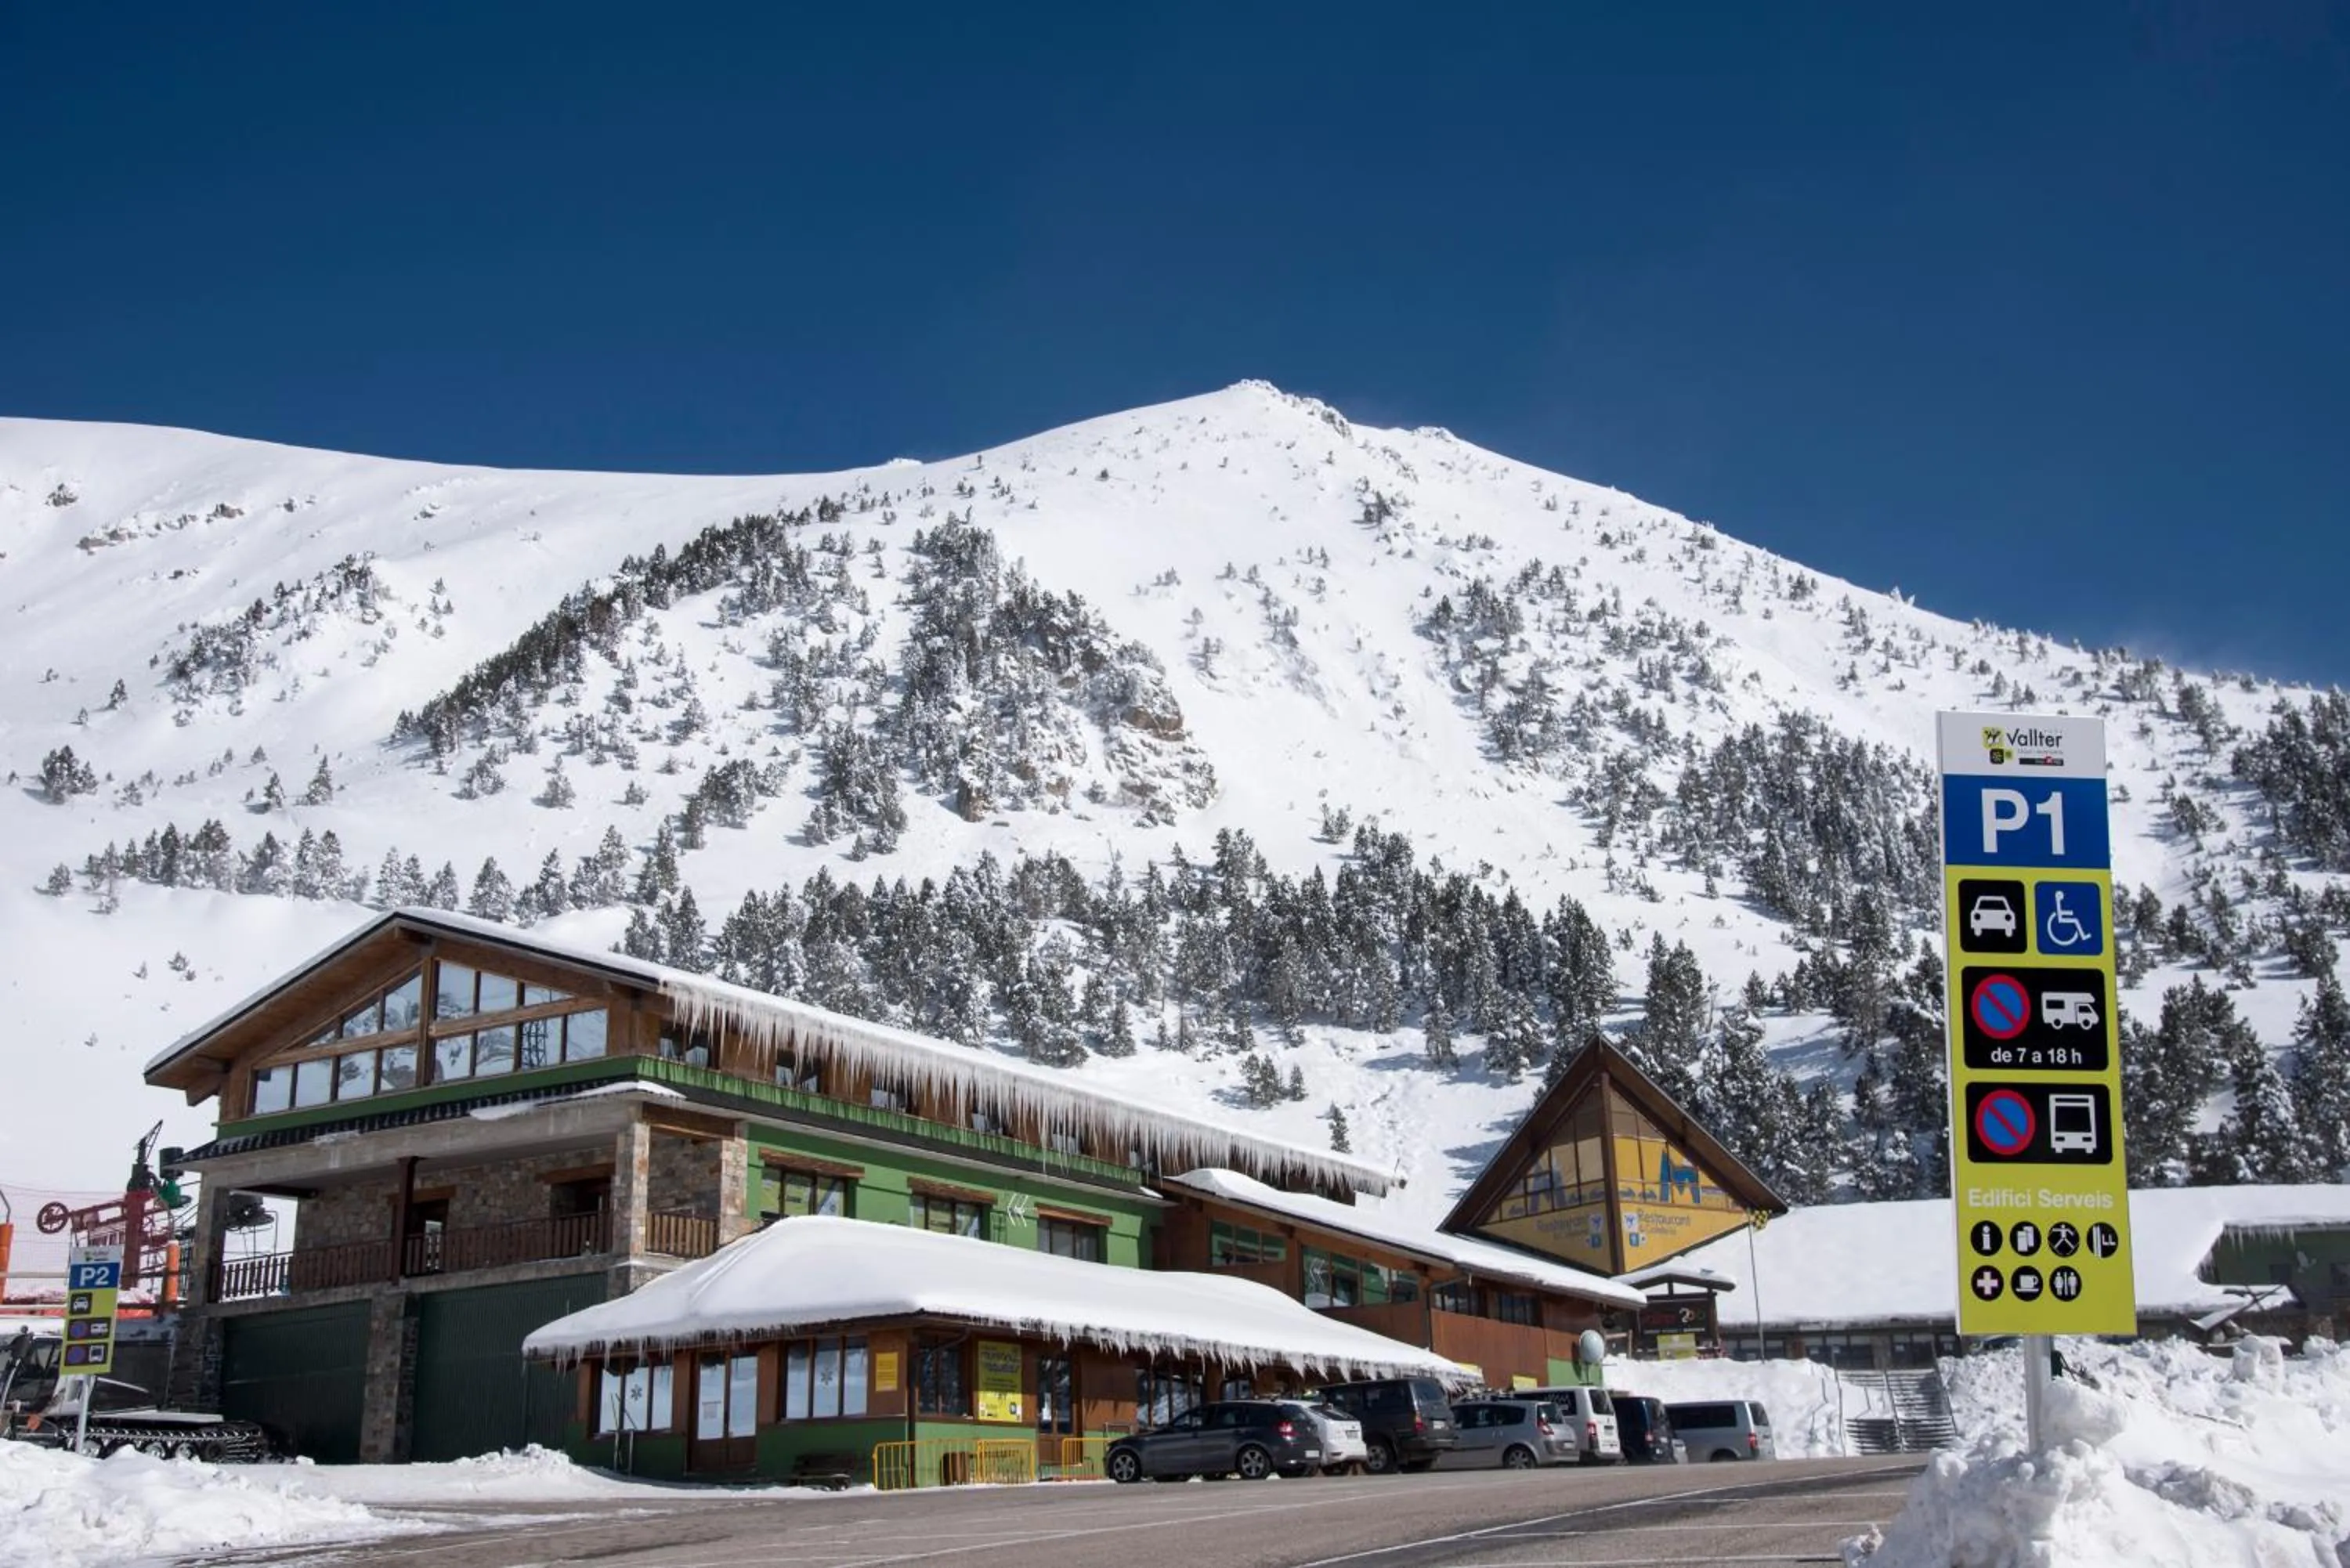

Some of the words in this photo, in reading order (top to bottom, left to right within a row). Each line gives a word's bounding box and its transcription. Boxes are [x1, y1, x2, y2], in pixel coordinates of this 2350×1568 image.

[2007, 728, 2063, 748] Vallter
[1981, 789, 2065, 855] P1
[1990, 1046, 2012, 1063] de
[2016, 1047, 2027, 1063] 7
[2031, 1050, 2042, 1064] a
[2047, 1047, 2068, 1064] 18
[2070, 1047, 2082, 1064] h
[1968, 1187, 2031, 1207] Edifici
[2037, 1189, 2114, 1209] Serveis
[79, 1266, 110, 1287] P2
